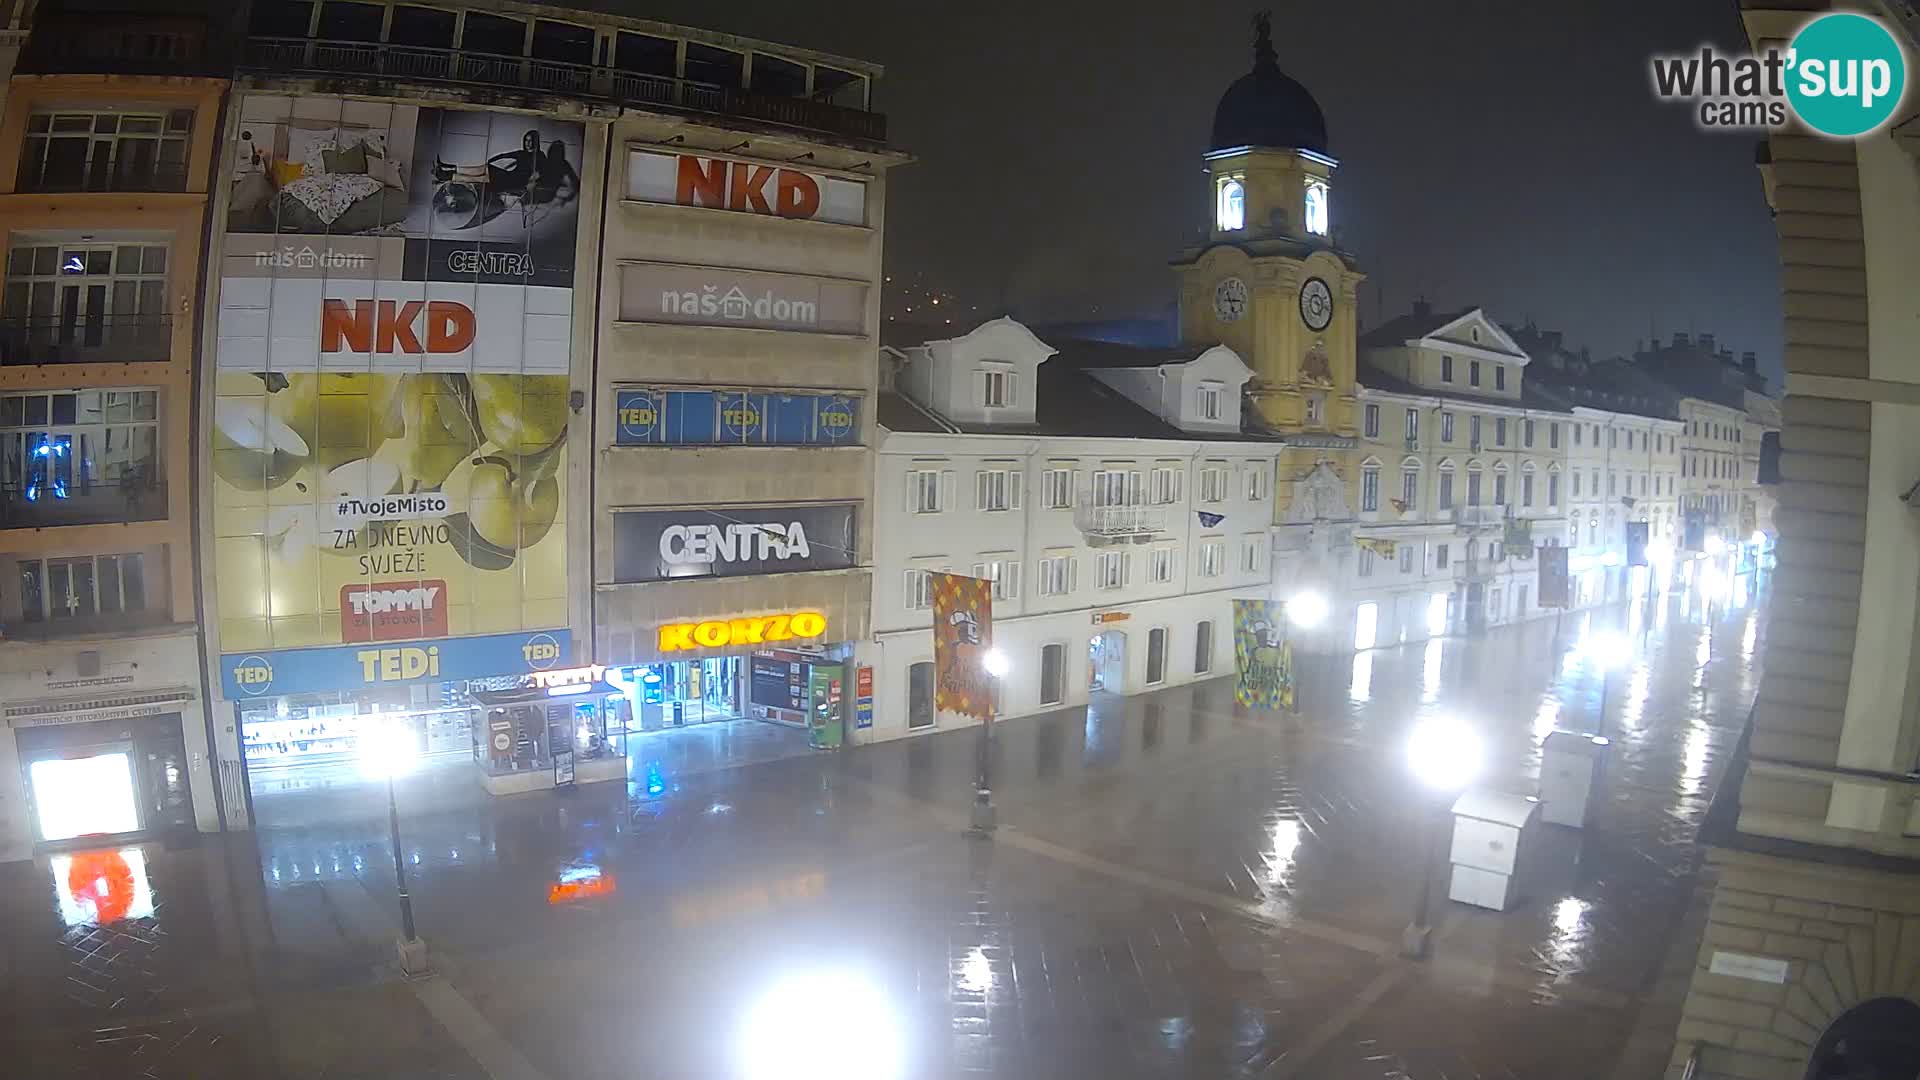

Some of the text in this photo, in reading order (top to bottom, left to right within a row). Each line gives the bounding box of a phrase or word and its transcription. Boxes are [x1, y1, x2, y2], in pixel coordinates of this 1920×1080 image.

[676, 155, 820, 220] NKD
[319, 247, 366, 269] dom
[448, 250, 535, 276] CENTRA
[661, 284, 817, 324] naš dom
[321, 299, 477, 354] NKD
[619, 408, 657, 426] TEDi
[724, 409, 760, 426] TEDi
[820, 412, 853, 427] TEDi
[338, 497, 446, 517] #TvojeMisto
[334, 529, 357, 549] ZA
[659, 521, 810, 564] CENTRA
[359, 548, 426, 576] SVJEŽE
[349, 587, 439, 614] TOMMY
[658, 612, 826, 651] KORZO
[358, 646, 440, 682] TEDi
[522, 643, 560, 661] TEDi
[233, 665, 273, 684] TEDi
